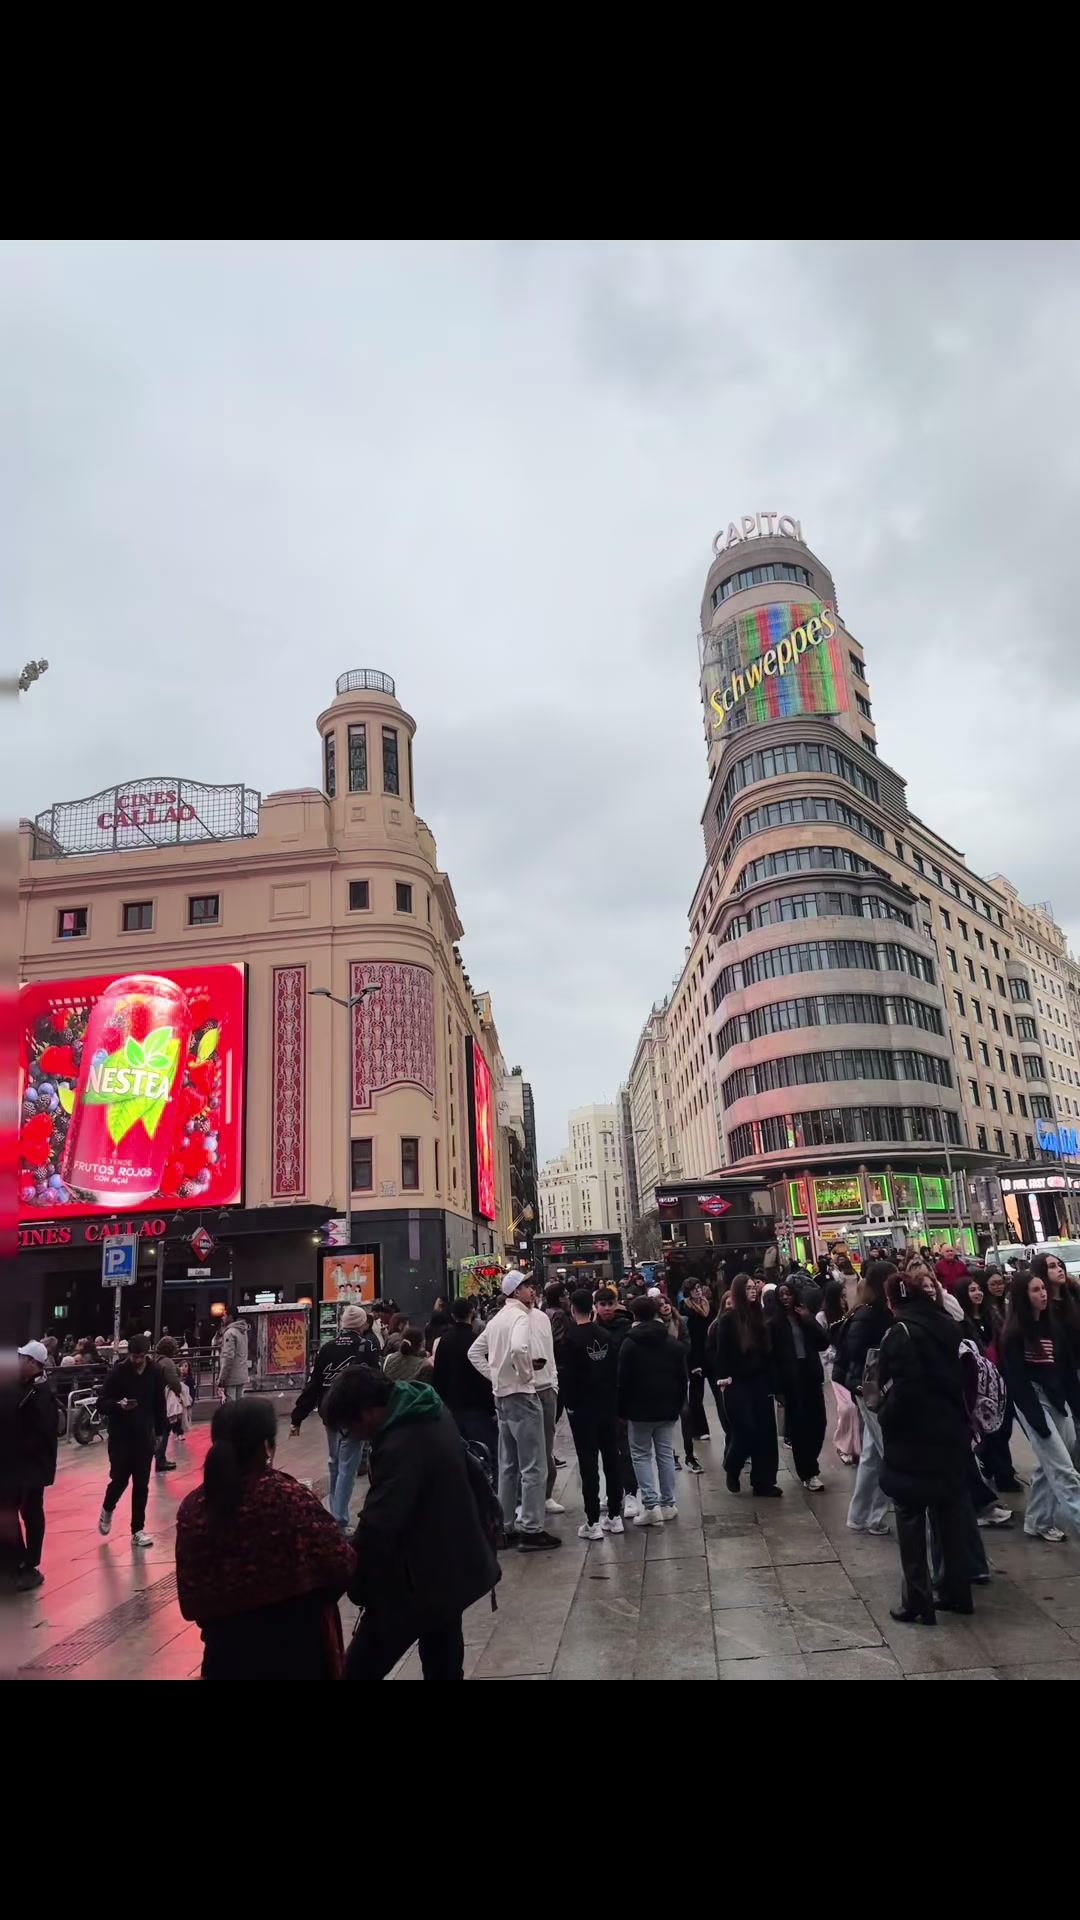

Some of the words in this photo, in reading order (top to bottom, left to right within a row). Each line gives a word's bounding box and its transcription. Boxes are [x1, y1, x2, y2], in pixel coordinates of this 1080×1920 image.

[712, 511, 807, 556] CAPITOL
[710, 607, 836, 731] Schweppes
[117, 790, 177, 809] CINES
[97, 804, 196, 831] CALLAO
[85, 1064, 170, 1102] NESTEA
[73, 1160, 115, 1176] FRUTOS
[118, 1166, 153, 1178] ROJOS
[94, 1174, 110, 1182] CON
[85, 1218, 167, 1241] CALLAO
[107, 1248, 126, 1273] P
[275, 1325, 303, 1336] YANA
